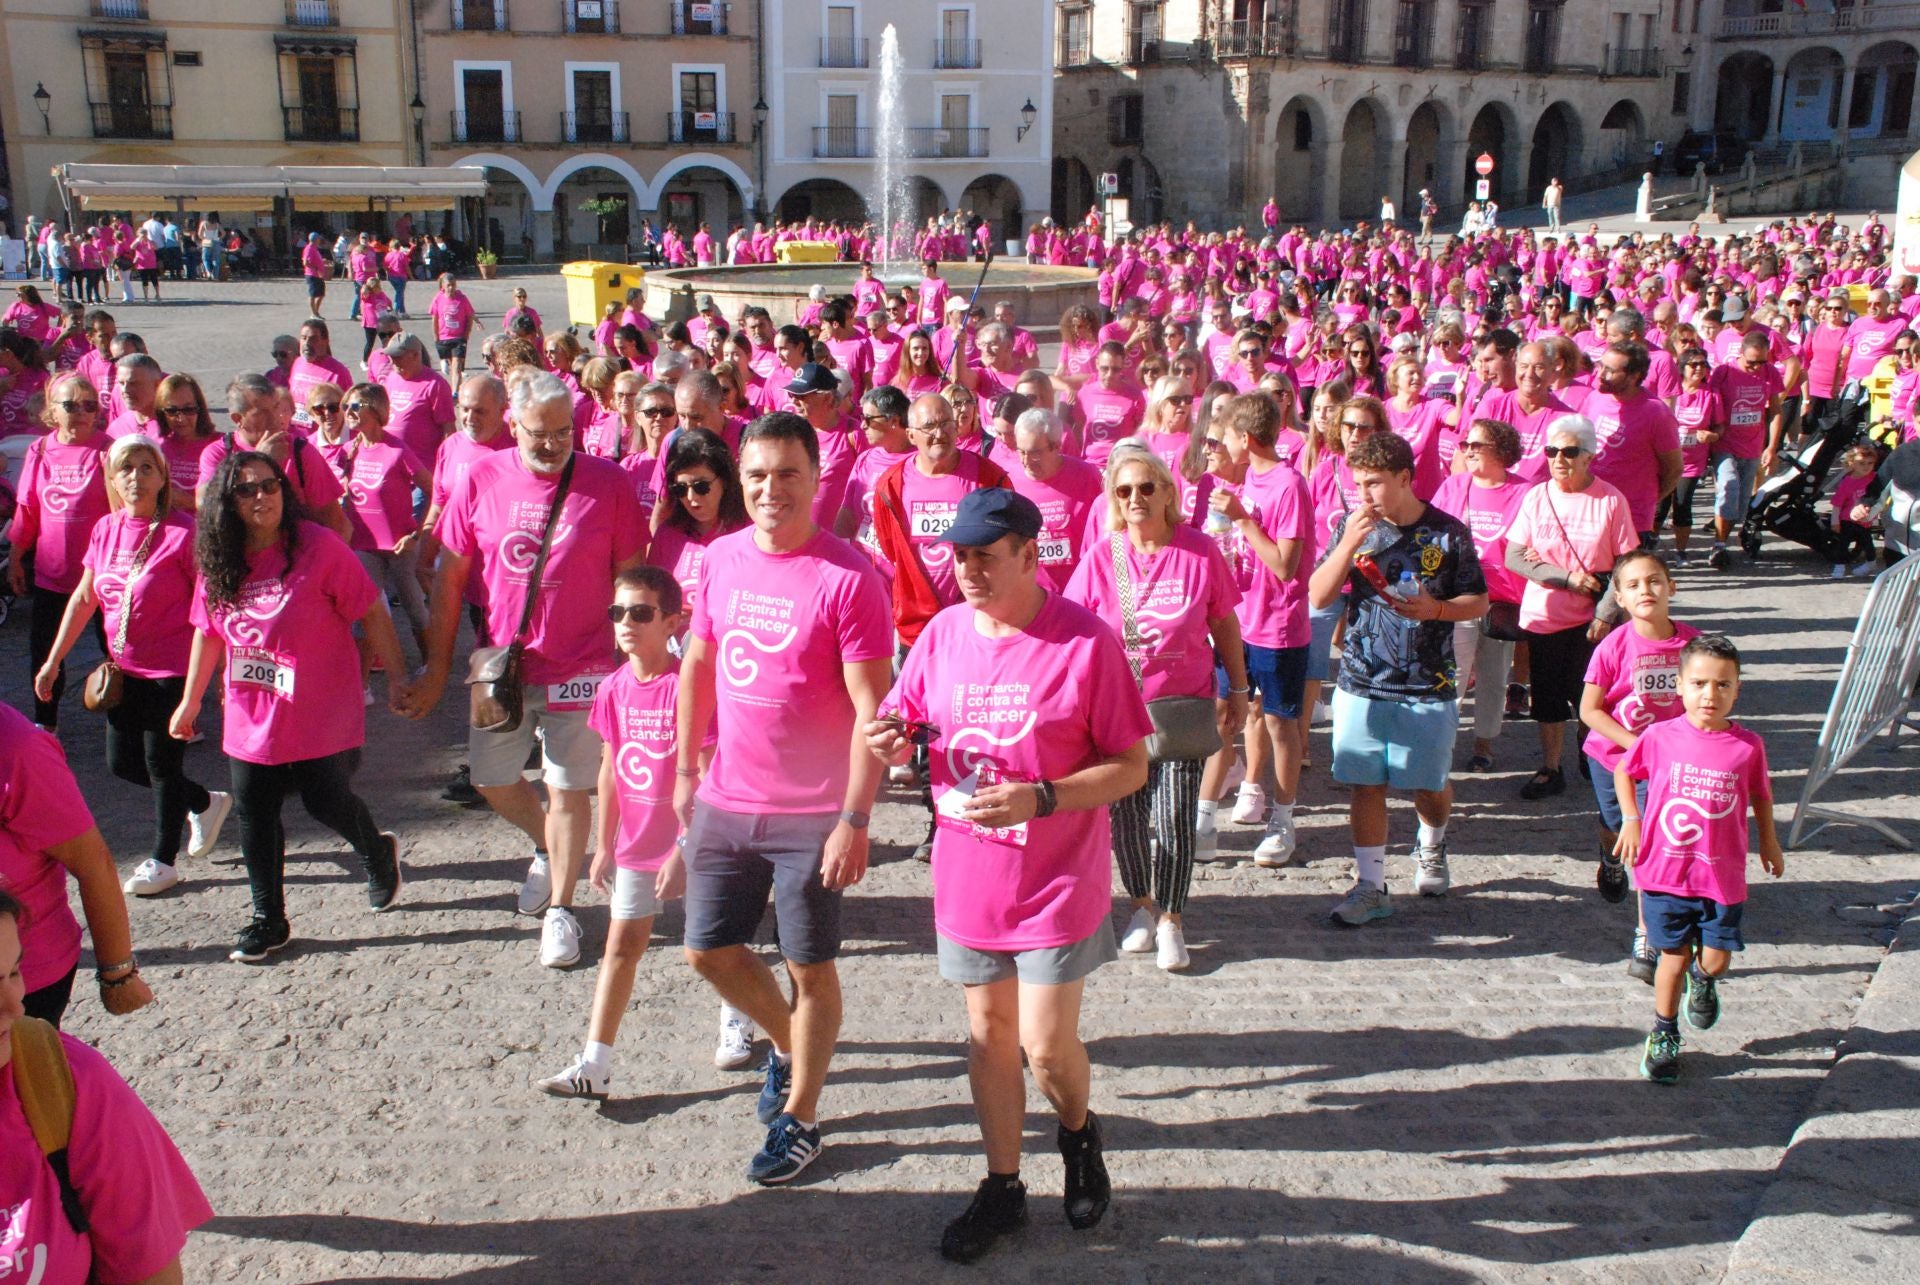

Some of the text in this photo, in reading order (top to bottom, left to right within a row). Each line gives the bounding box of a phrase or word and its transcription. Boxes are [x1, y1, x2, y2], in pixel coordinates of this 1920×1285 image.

[1737, 415, 1757, 423] 1270
[521, 501, 532, 509] En
[1043, 513, 1065, 522] ncer
[921, 519, 954, 533] 029
[271, 583, 283, 593] el
[1172, 584, 1184, 593] el
[742, 590, 795, 609] En marcha
[740, 602, 792, 619] contra el
[737, 613, 790, 635] cáncer
[243, 664, 284, 687] 2091
[1638, 673, 1677, 691] 1983
[968, 682, 1030, 694] En marcha
[966, 692, 1028, 707] contra el
[628, 706, 639, 716] En
[967, 707, 1027, 723] cáncer
[628, 717, 661, 727] contra
[629, 727, 674, 740] cáncer
[1684, 763, 1740, 780] En marcha
[1682, 774, 1735, 790] contra el
[1681, 784, 1734, 802] cáncer
